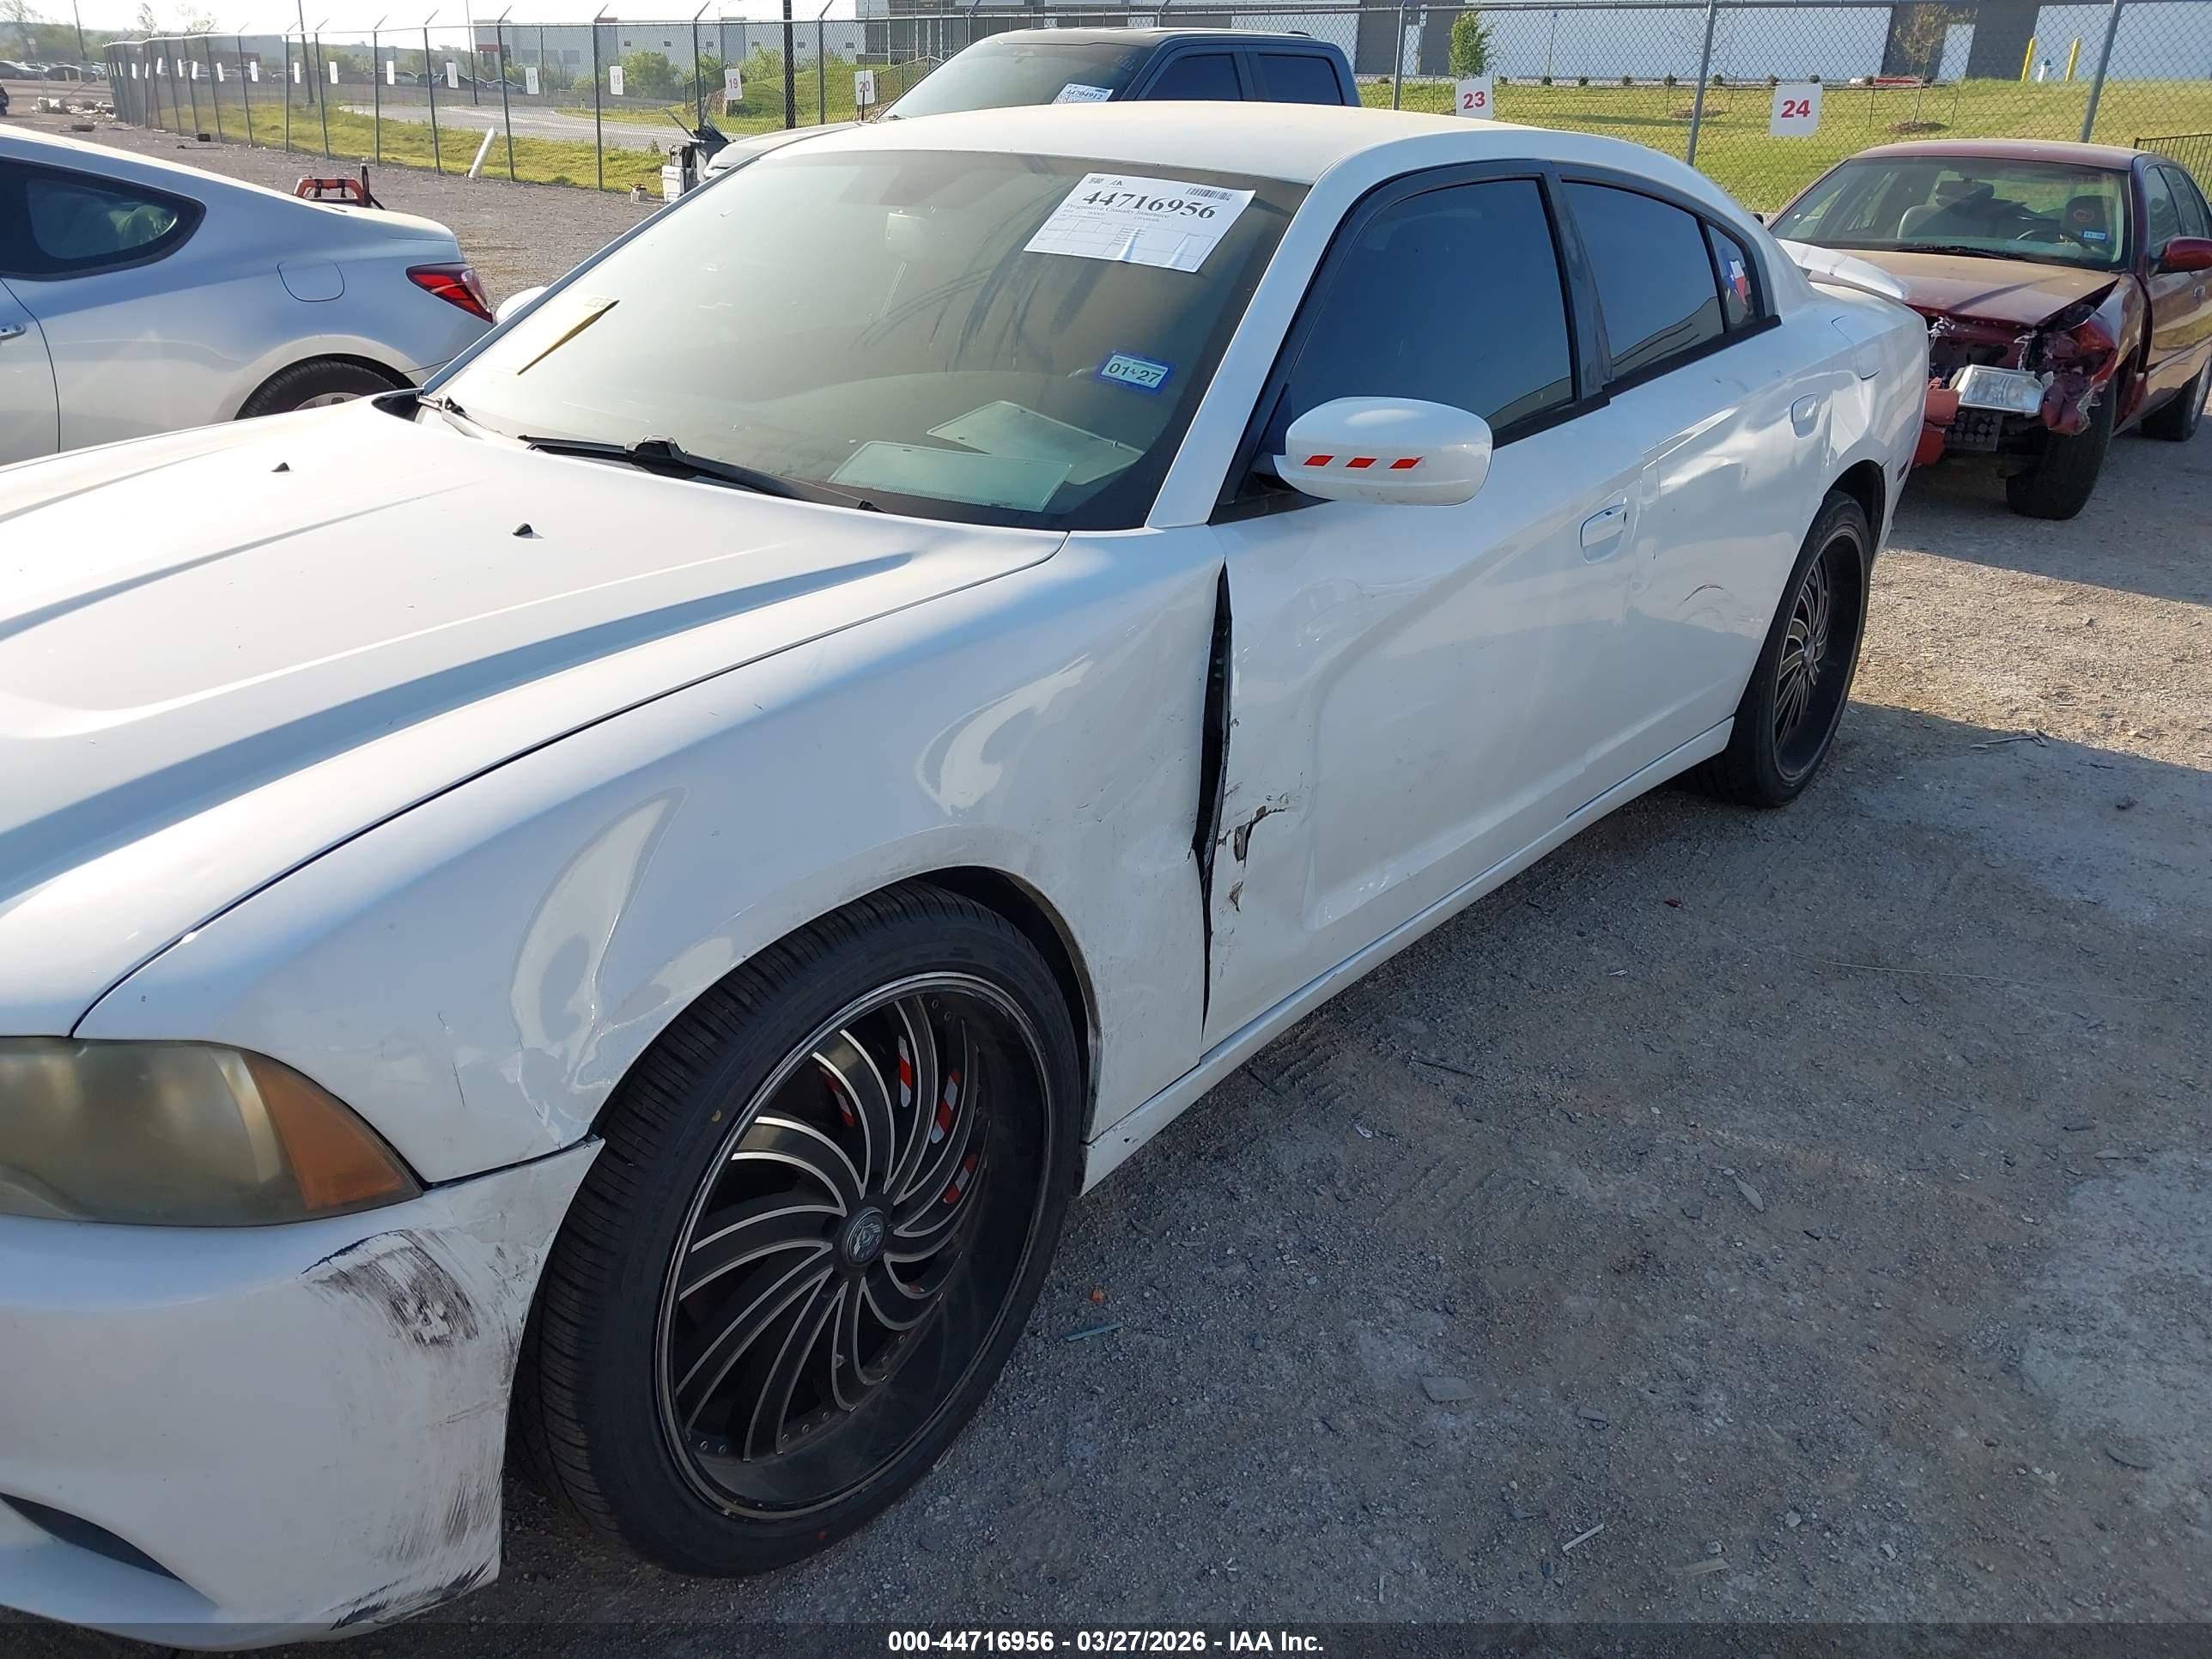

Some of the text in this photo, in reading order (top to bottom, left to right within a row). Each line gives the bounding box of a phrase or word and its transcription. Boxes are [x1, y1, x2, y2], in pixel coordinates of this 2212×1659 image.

[728, 77, 738, 89] 19
[859, 81, 871, 93] 20
[1463, 91, 1486, 109] 23
[1781, 100, 1811, 118] 24
[1083, 191, 1221, 219] 44716956
